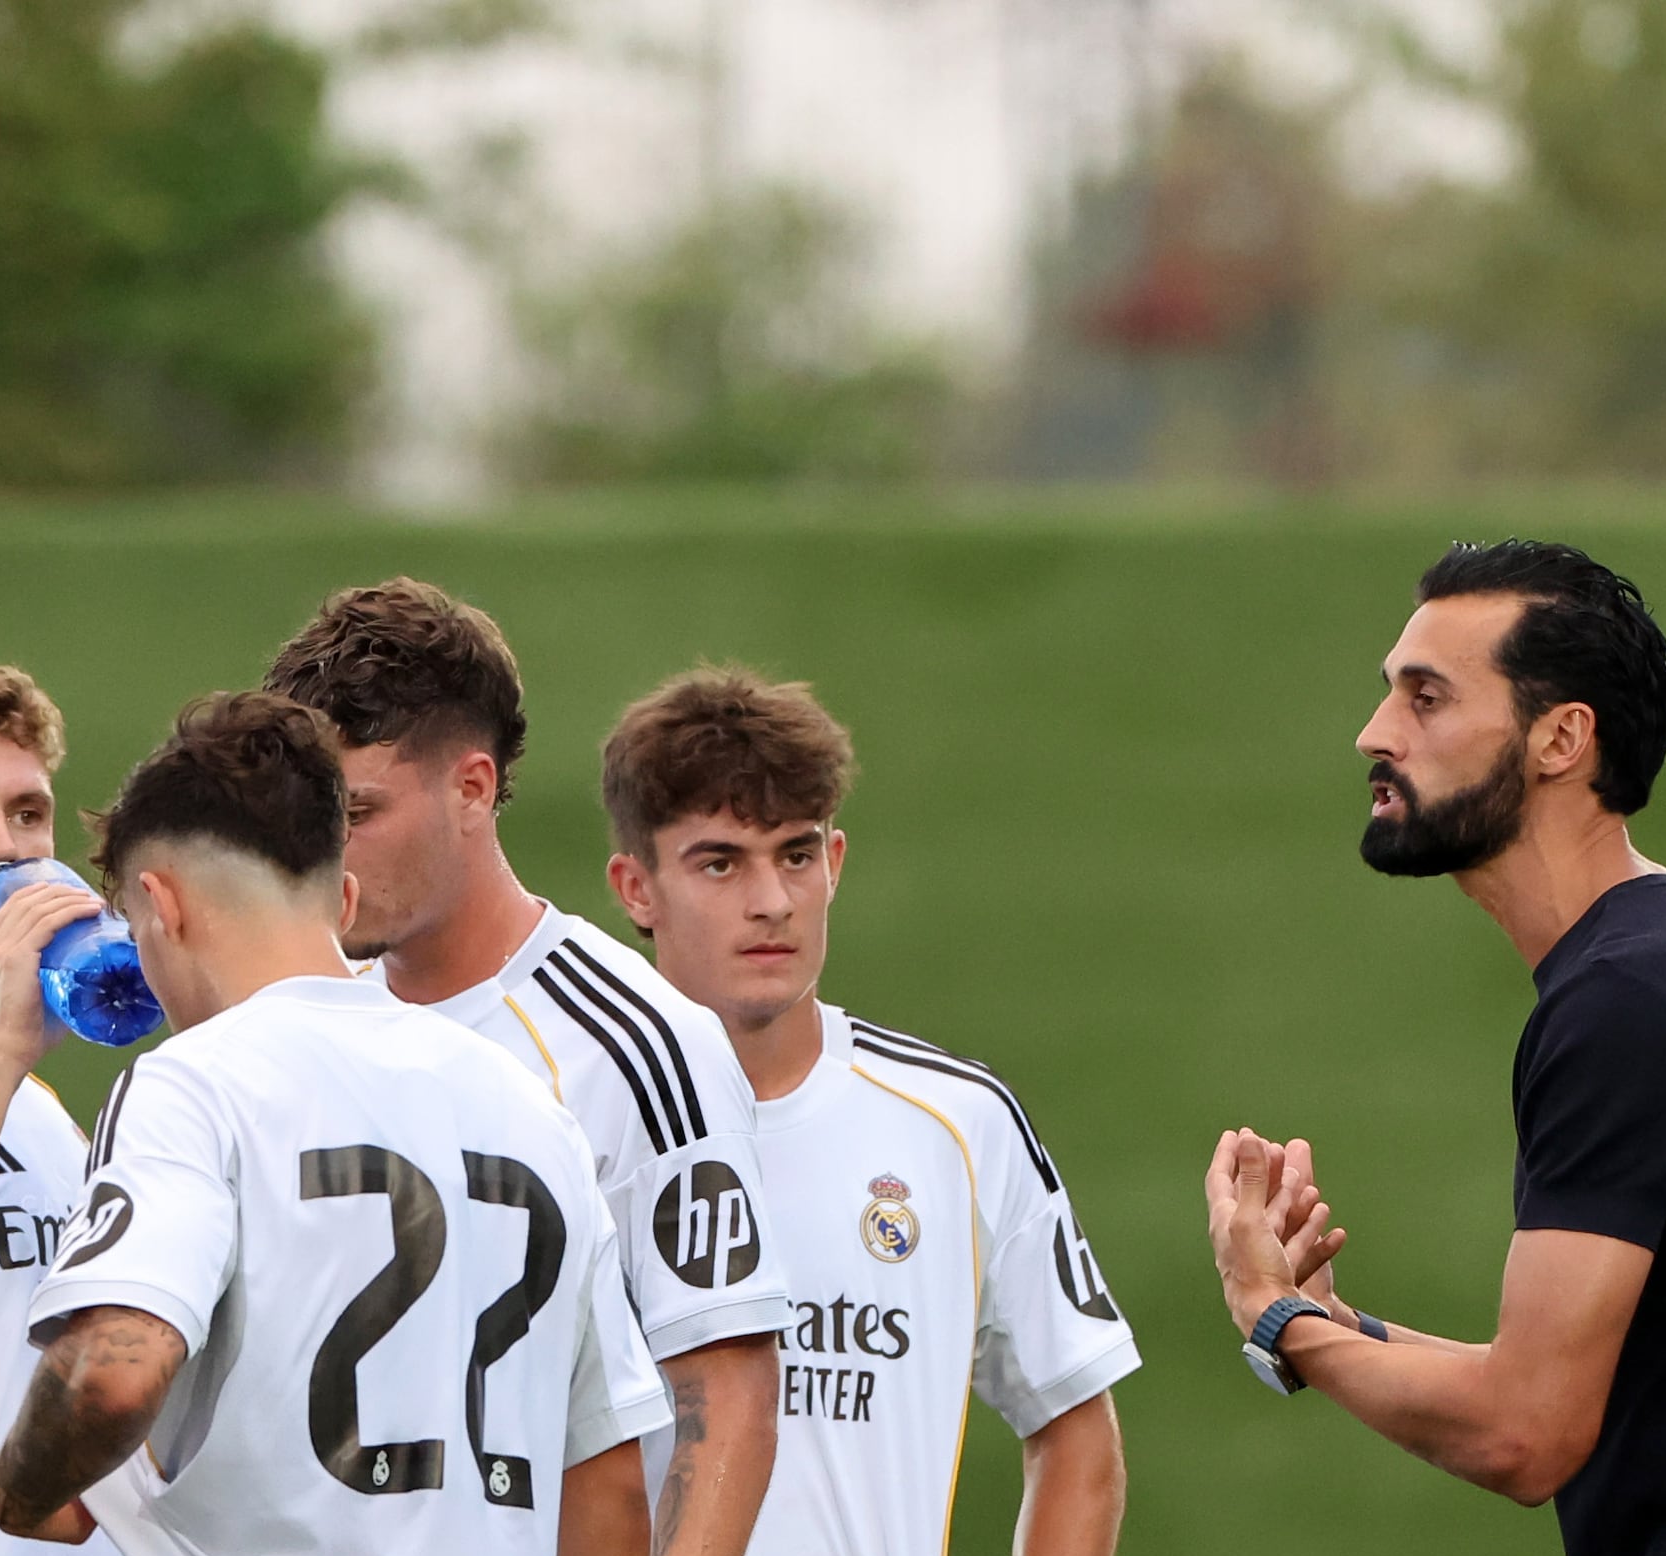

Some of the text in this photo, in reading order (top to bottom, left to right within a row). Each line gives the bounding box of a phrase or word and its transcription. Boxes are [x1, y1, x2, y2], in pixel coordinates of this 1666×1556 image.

[668, 1161, 755, 1289] hp
[299, 1143, 567, 1510] 22
[784, 1364, 875, 1422] ETTER
